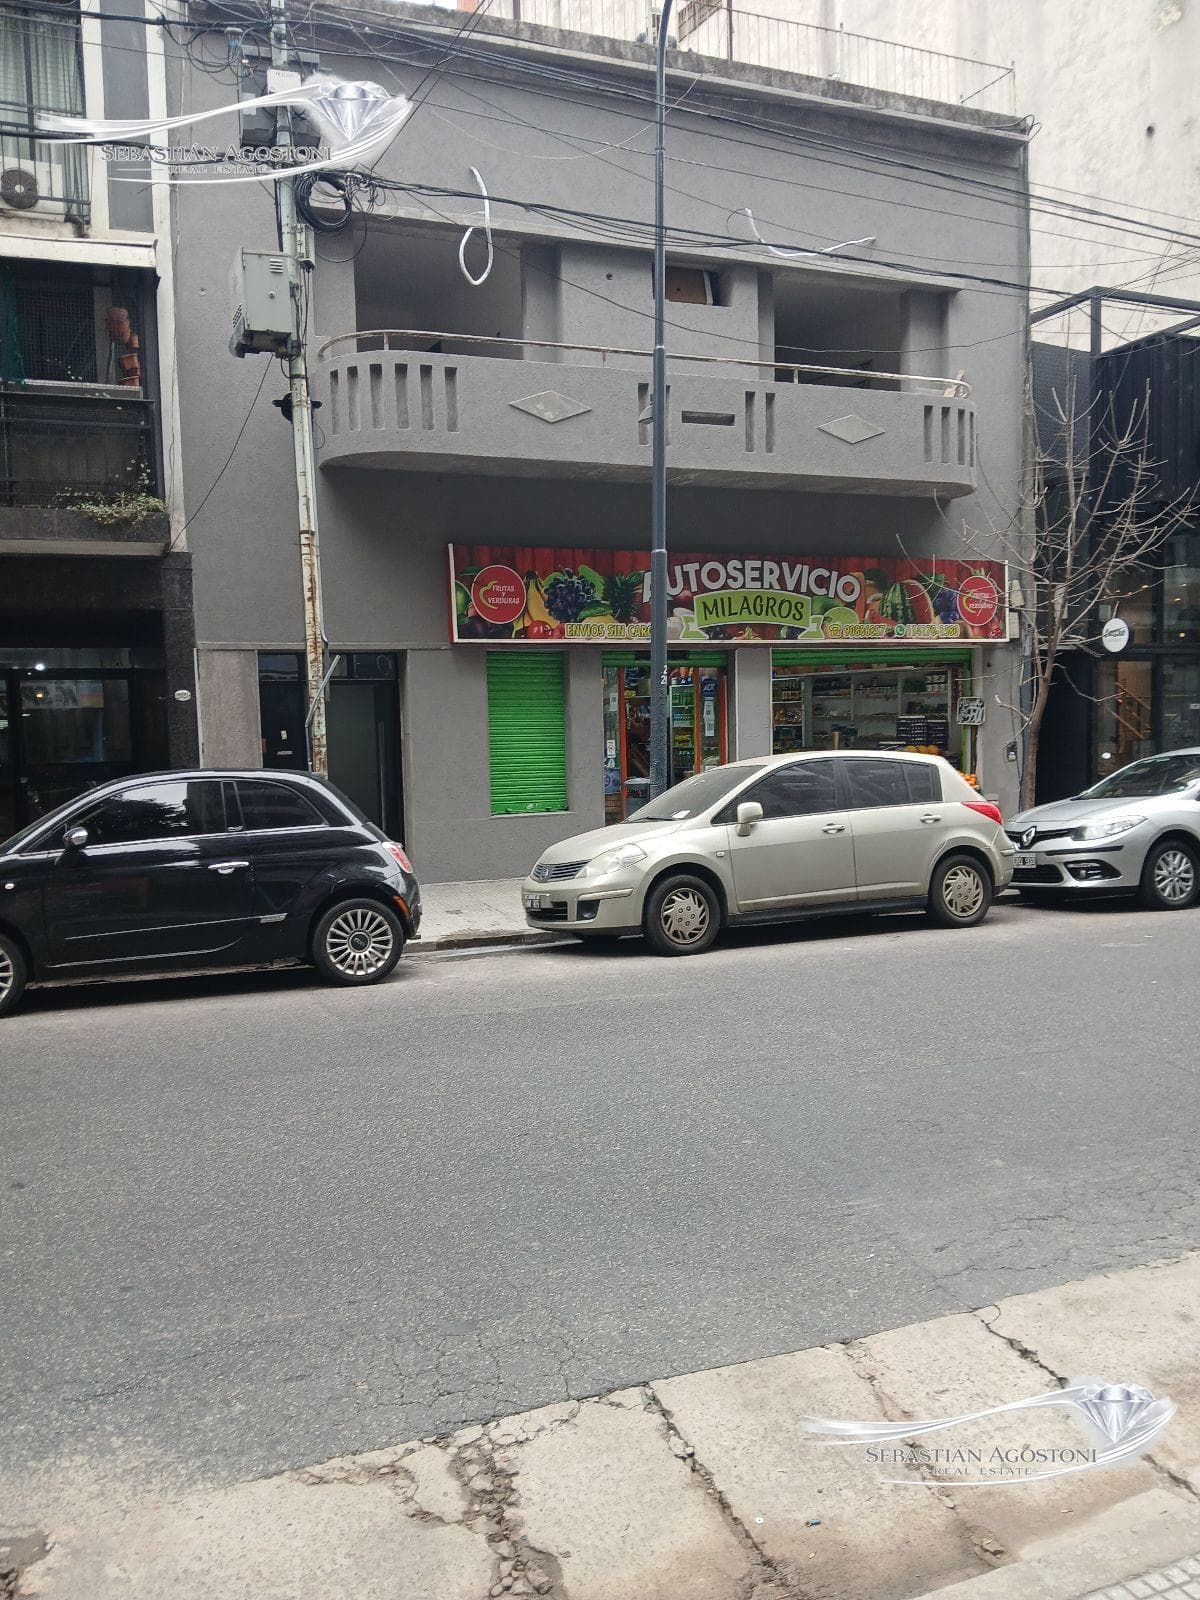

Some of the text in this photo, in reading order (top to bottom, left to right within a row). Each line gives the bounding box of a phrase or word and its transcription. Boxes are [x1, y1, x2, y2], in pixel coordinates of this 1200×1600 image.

[702, 595, 804, 622] MILAGROS
[566, 623, 605, 637] ENVIOS
[606, 623, 626, 637] SIN
